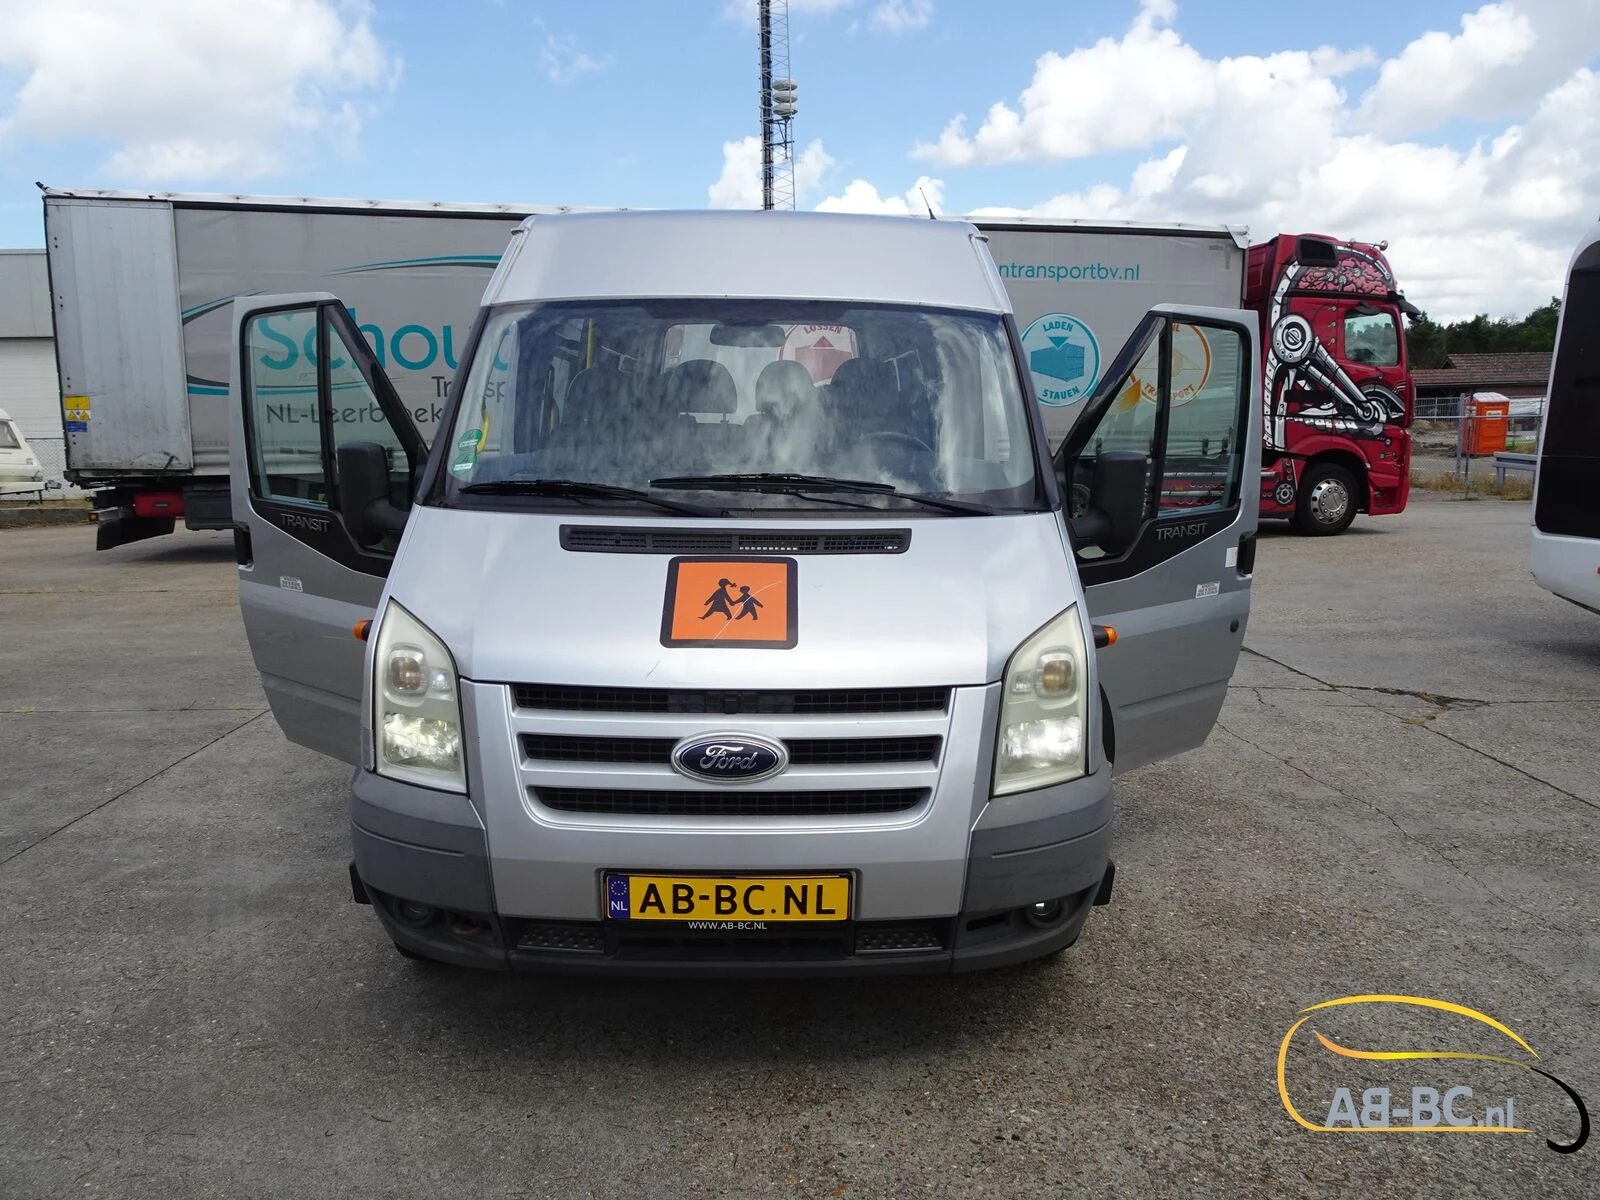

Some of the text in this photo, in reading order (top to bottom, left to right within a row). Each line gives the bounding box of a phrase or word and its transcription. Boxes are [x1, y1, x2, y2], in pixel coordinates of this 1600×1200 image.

[998, 262, 1140, 282] ntransportbv.nl
[1043, 321, 1073, 332] LADEN
[1042, 386, 1080, 399] STAUEN
[280, 513, 330, 532] TRANSIT
[1156, 523, 1208, 540] TRANSIT
[700, 745, 758, 769] Ford
[611, 901, 628, 911] NL
[638, 883, 836, 915] AB-BC.NL
[688, 921, 767, 930] WWW.AB-BC.NL
